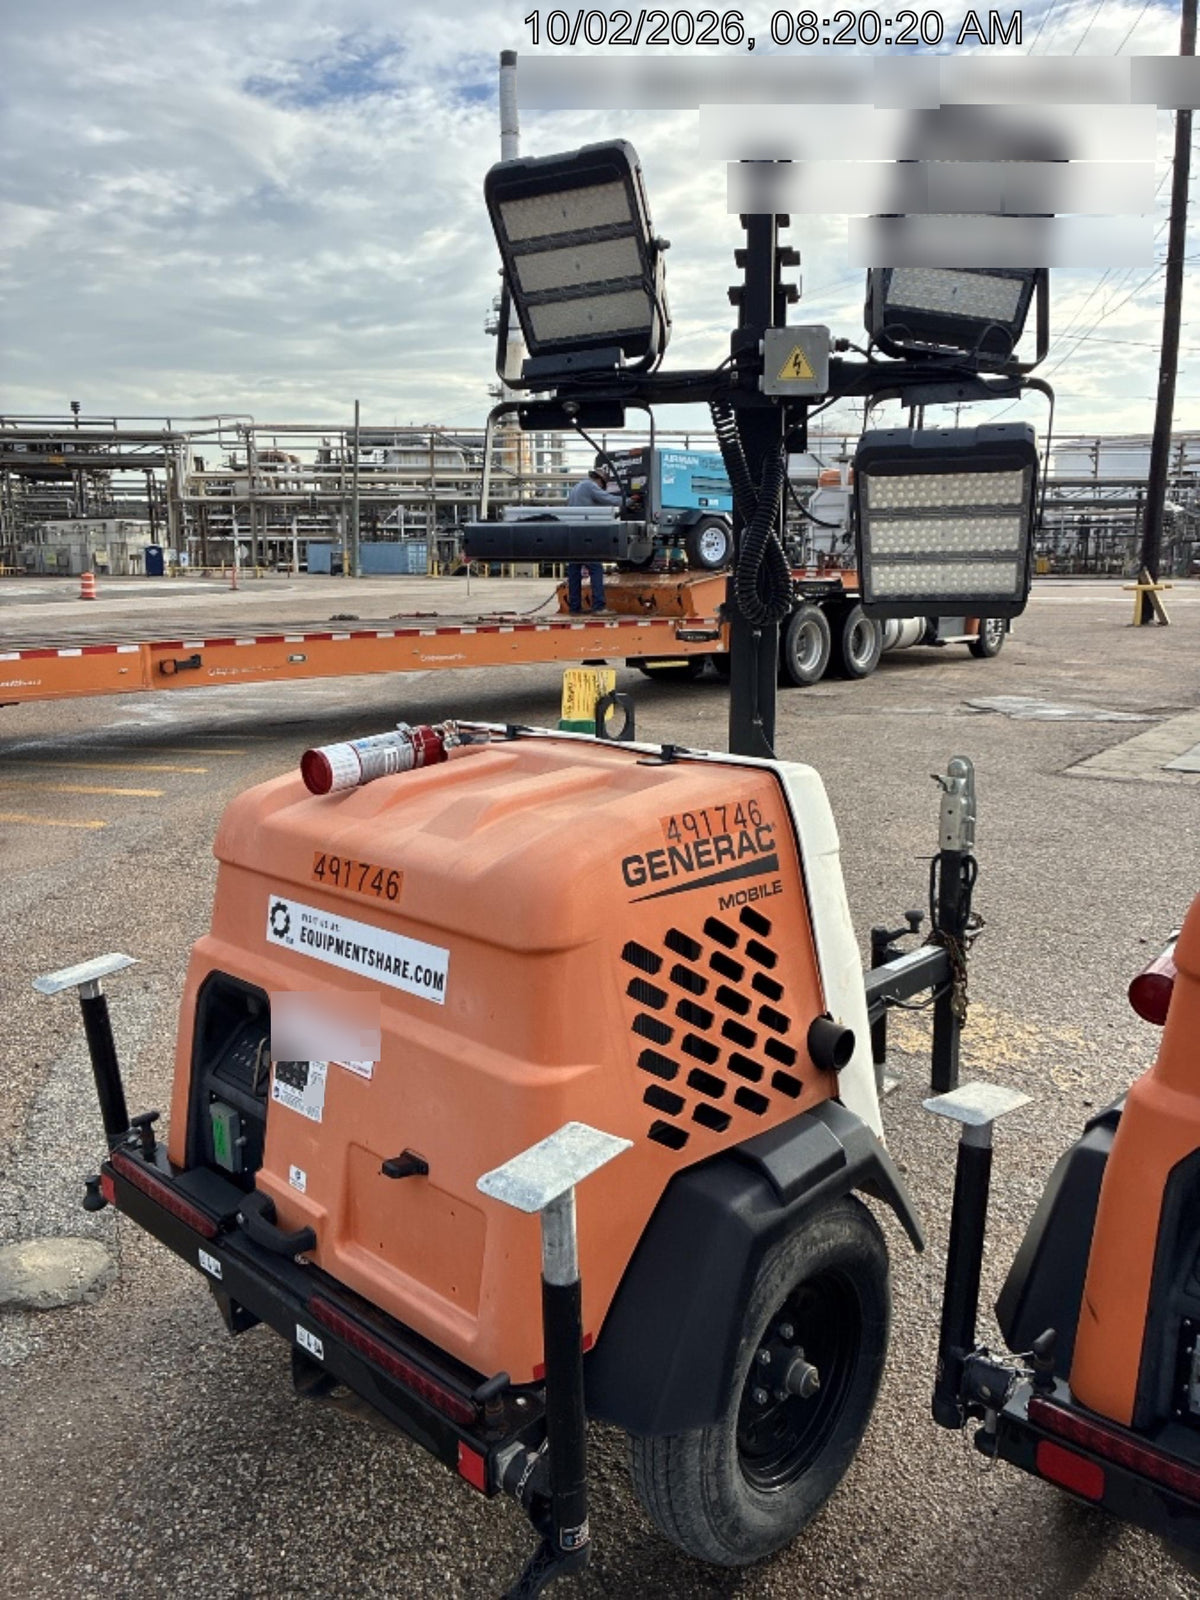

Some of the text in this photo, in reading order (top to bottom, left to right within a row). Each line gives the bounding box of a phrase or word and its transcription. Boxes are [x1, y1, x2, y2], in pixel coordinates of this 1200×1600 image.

[667, 799, 762, 843] 491746
[314, 854, 400, 901] 491746
[621, 824, 776, 888] GENERAC
[718, 880, 783, 911] MOBILE
[299, 925, 445, 992] EQUIPMENTSHARE.COM
